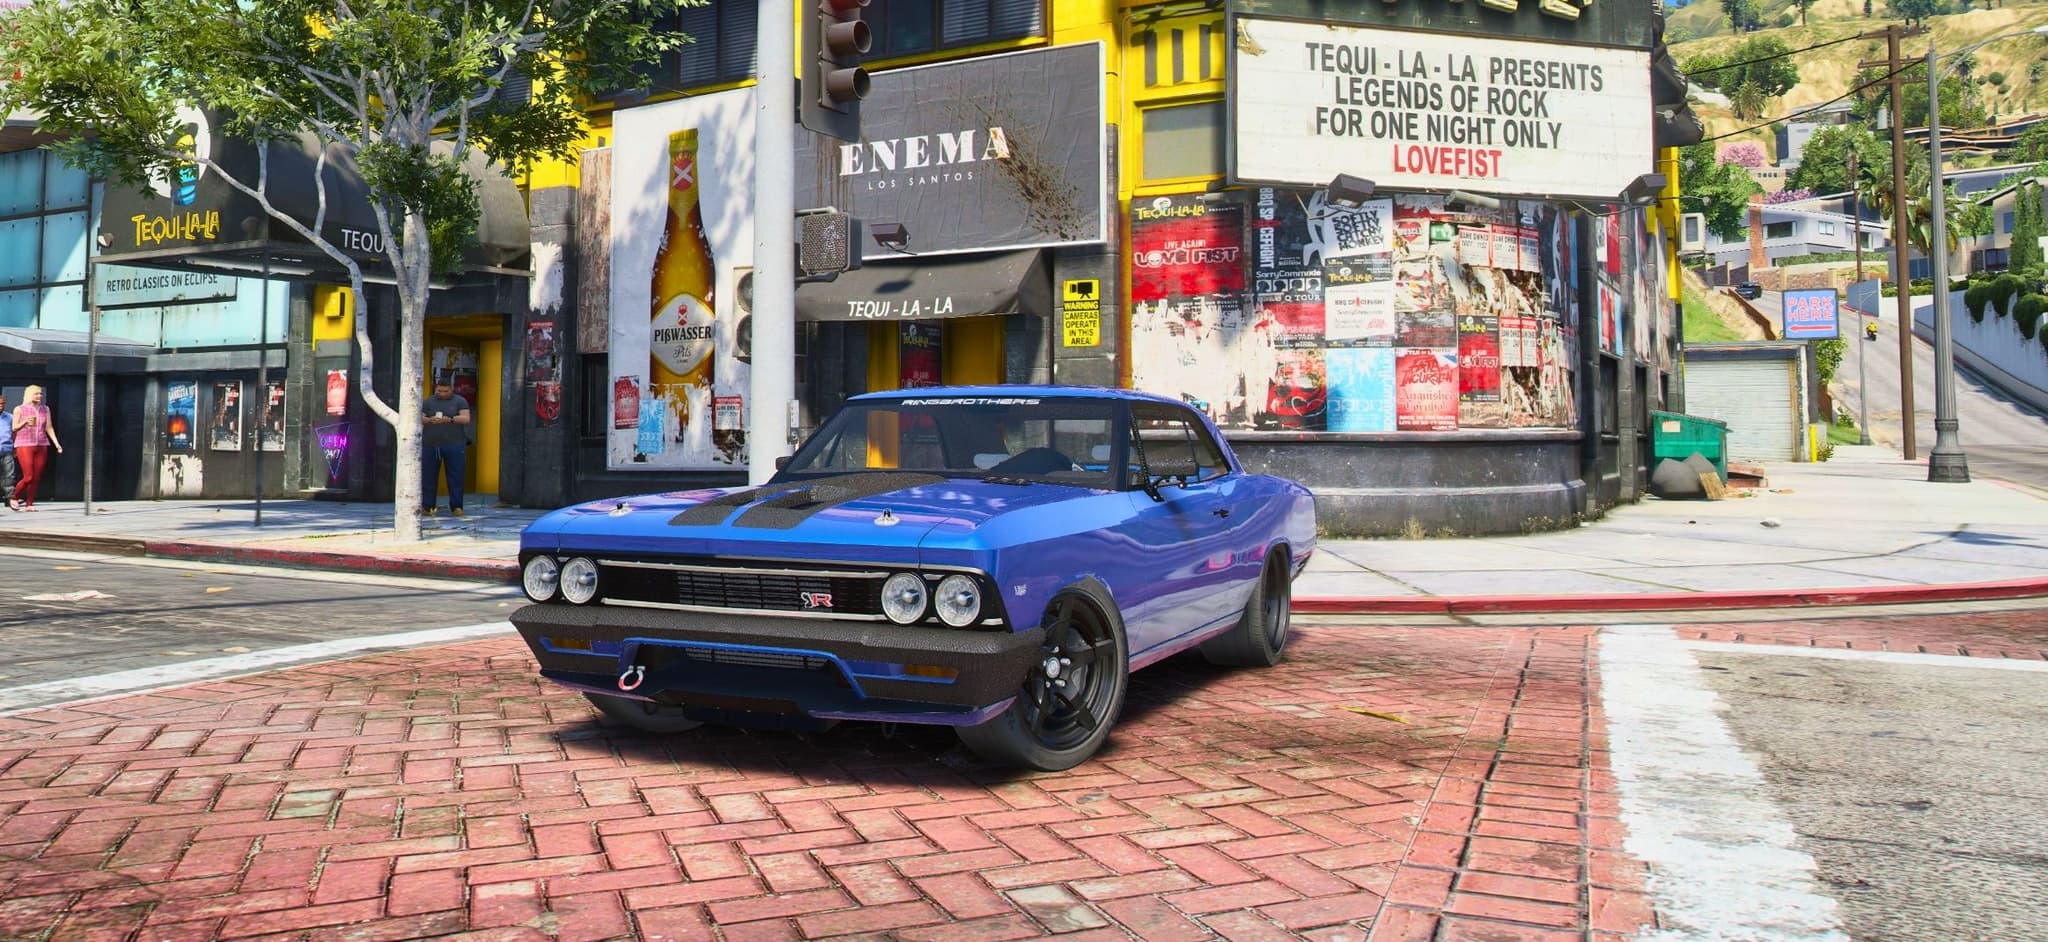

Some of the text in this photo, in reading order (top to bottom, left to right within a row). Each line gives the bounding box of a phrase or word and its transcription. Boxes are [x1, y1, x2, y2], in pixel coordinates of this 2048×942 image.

[1305, 42, 1377, 76] TEQUI
[1399, 50, 1428, 79] LA
[1448, 54, 1476, 83] LA
[1490, 57, 1603, 92] PRESENTS
[1335, 76, 1548, 118] LEGENDS OF ROCK
[1316, 106, 1562, 149] FOR ONE NIGHT ONLY
[839, 126, 1011, 176] ENEMA
[1393, 144, 1502, 178] LOVEFIST
[868, 171, 974, 190] LOS SANTOS
[1192, 247, 1239, 265] FIST
[106, 272, 218, 292] RETRO CLASSICS ON ECLIPSE
[848, 301, 890, 317] TEQUI
[901, 300, 921, 316] LA
[934, 297, 953, 314] LA
[1064, 301, 1099, 311] WARNING
[1788, 296, 1833, 309] PARK
[1065, 311, 1098, 320] CAMERAS
[1065, 320, 1097, 328] OPERATE
[1788, 309, 1833, 322] HERE
[902, 398, 1041, 406] RINGBROTHERS
[320, 435, 347, 448] OPEN
